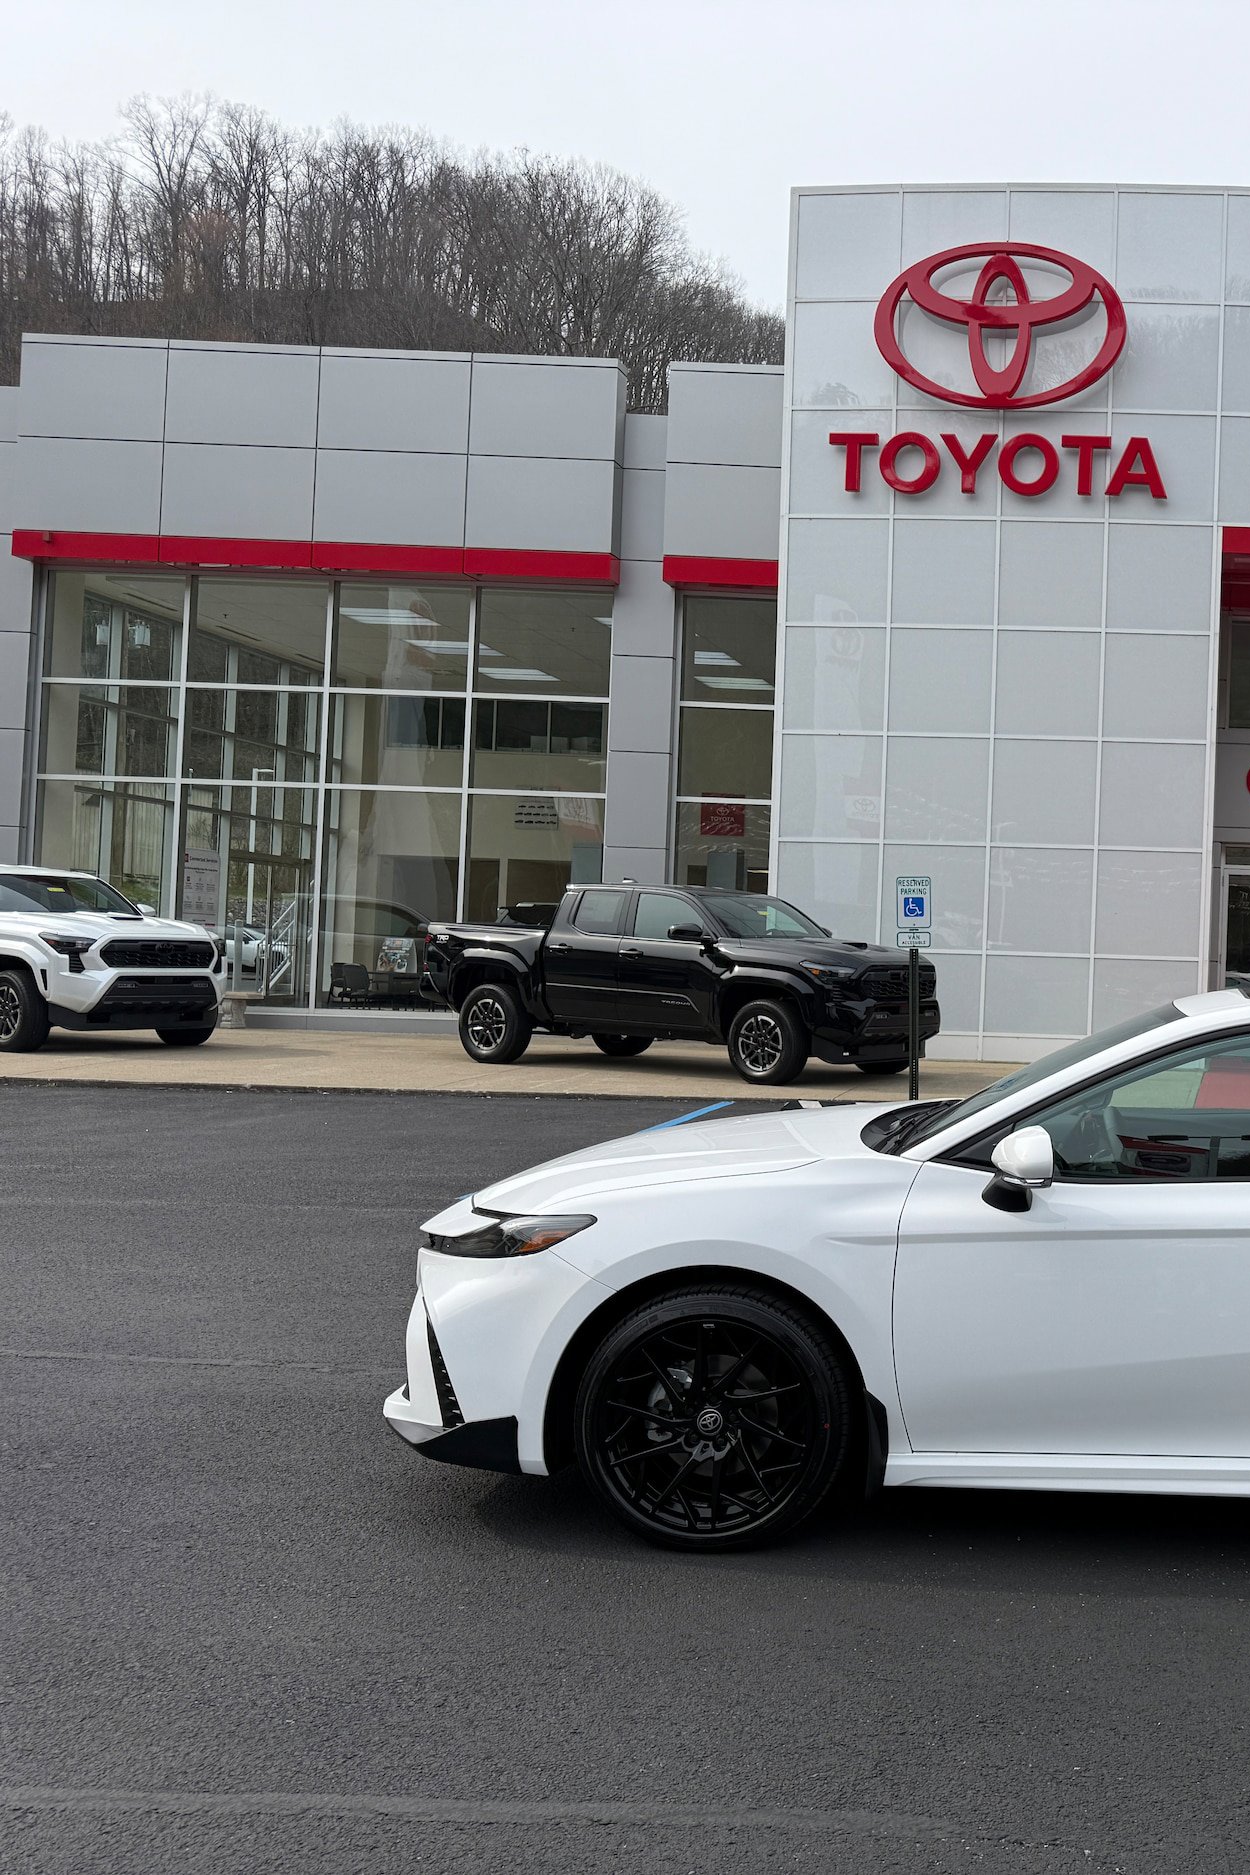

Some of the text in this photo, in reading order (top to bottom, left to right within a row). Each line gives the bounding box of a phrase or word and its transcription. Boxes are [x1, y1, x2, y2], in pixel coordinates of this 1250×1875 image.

[829, 431, 1168, 499] TOYOTA
[897, 879, 930, 887] RESERVED
[900, 887, 927, 895] PARKING
